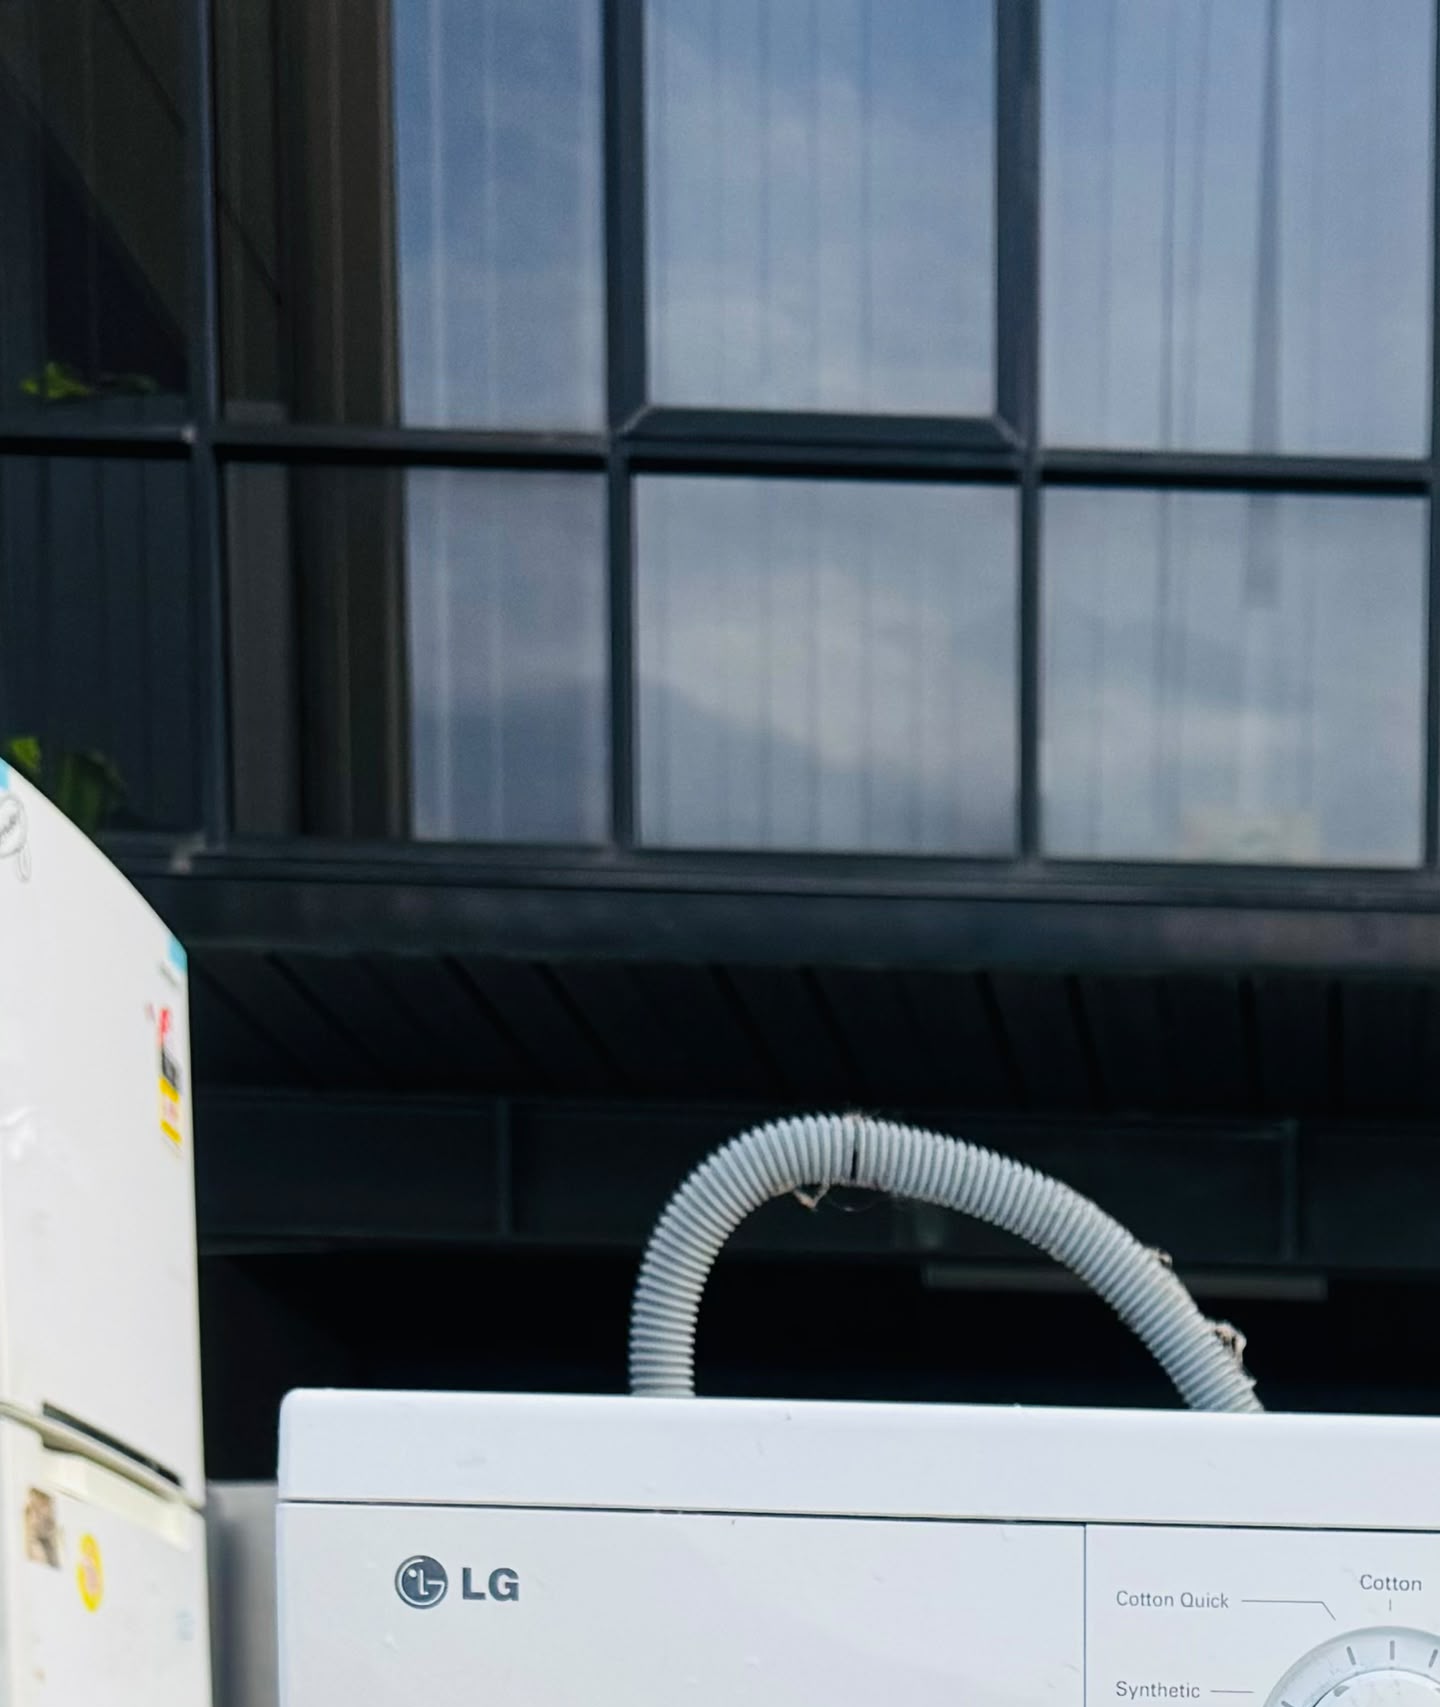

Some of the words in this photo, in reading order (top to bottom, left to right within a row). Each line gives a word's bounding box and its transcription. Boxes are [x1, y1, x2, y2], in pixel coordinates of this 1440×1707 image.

[462, 1567, 519, 1602] LG
[1360, 1574, 1422, 1592] Cotton
[1116, 1590, 1174, 1608] Cotton
[1180, 1591, 1229, 1609] Quick
[1116, 1680, 1200, 1700] Synthetic
